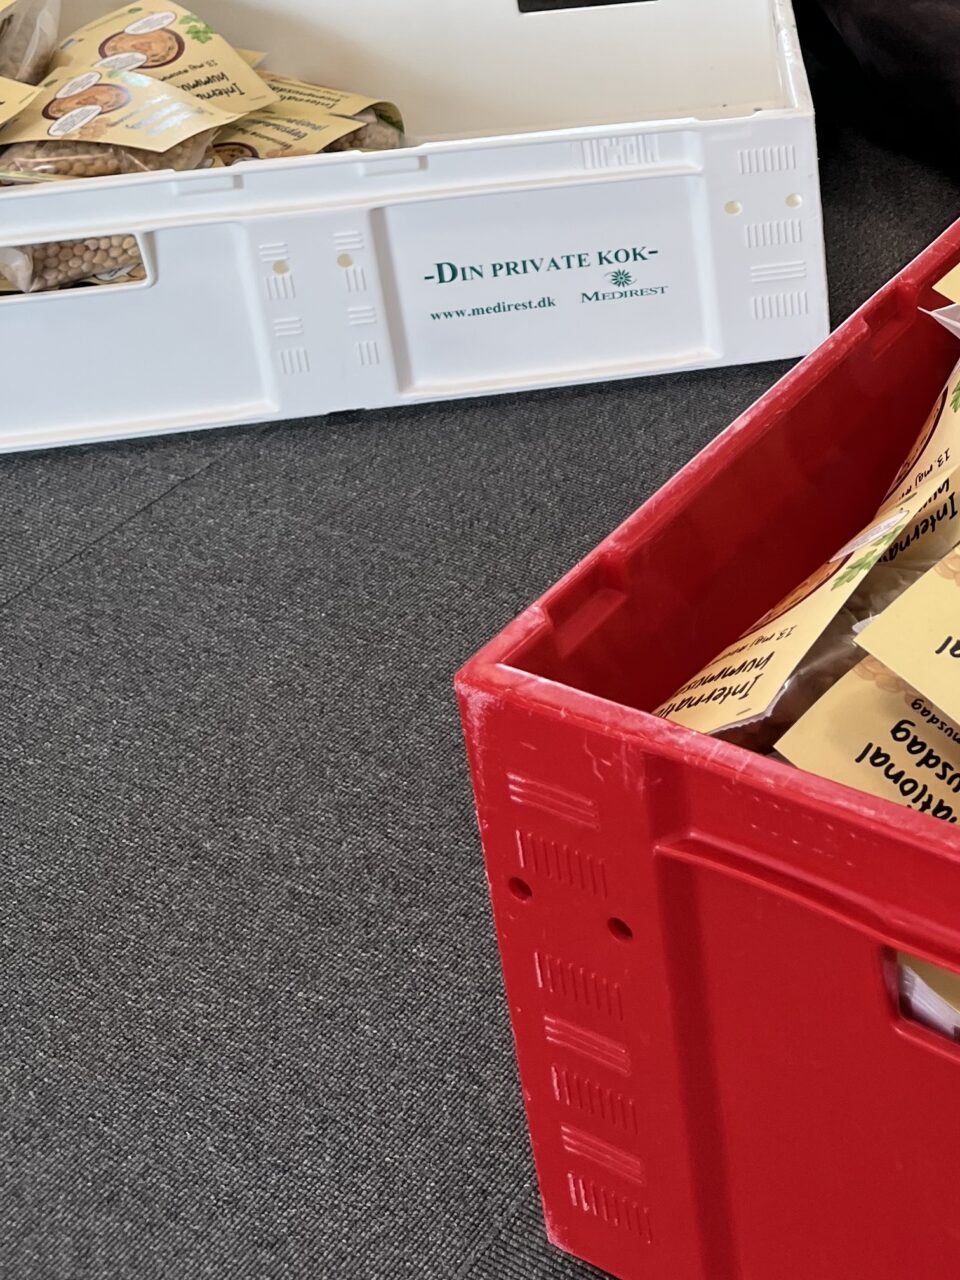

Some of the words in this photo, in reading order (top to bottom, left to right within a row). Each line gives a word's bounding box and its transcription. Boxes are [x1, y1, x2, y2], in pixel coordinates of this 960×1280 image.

[490, 252, 590, 278] PRIVATE
[597, 246, 658, 266] KOK-
[581, 285, 669, 303] MEDIREST
[430, 296, 556, 320] www.medirest.dk
